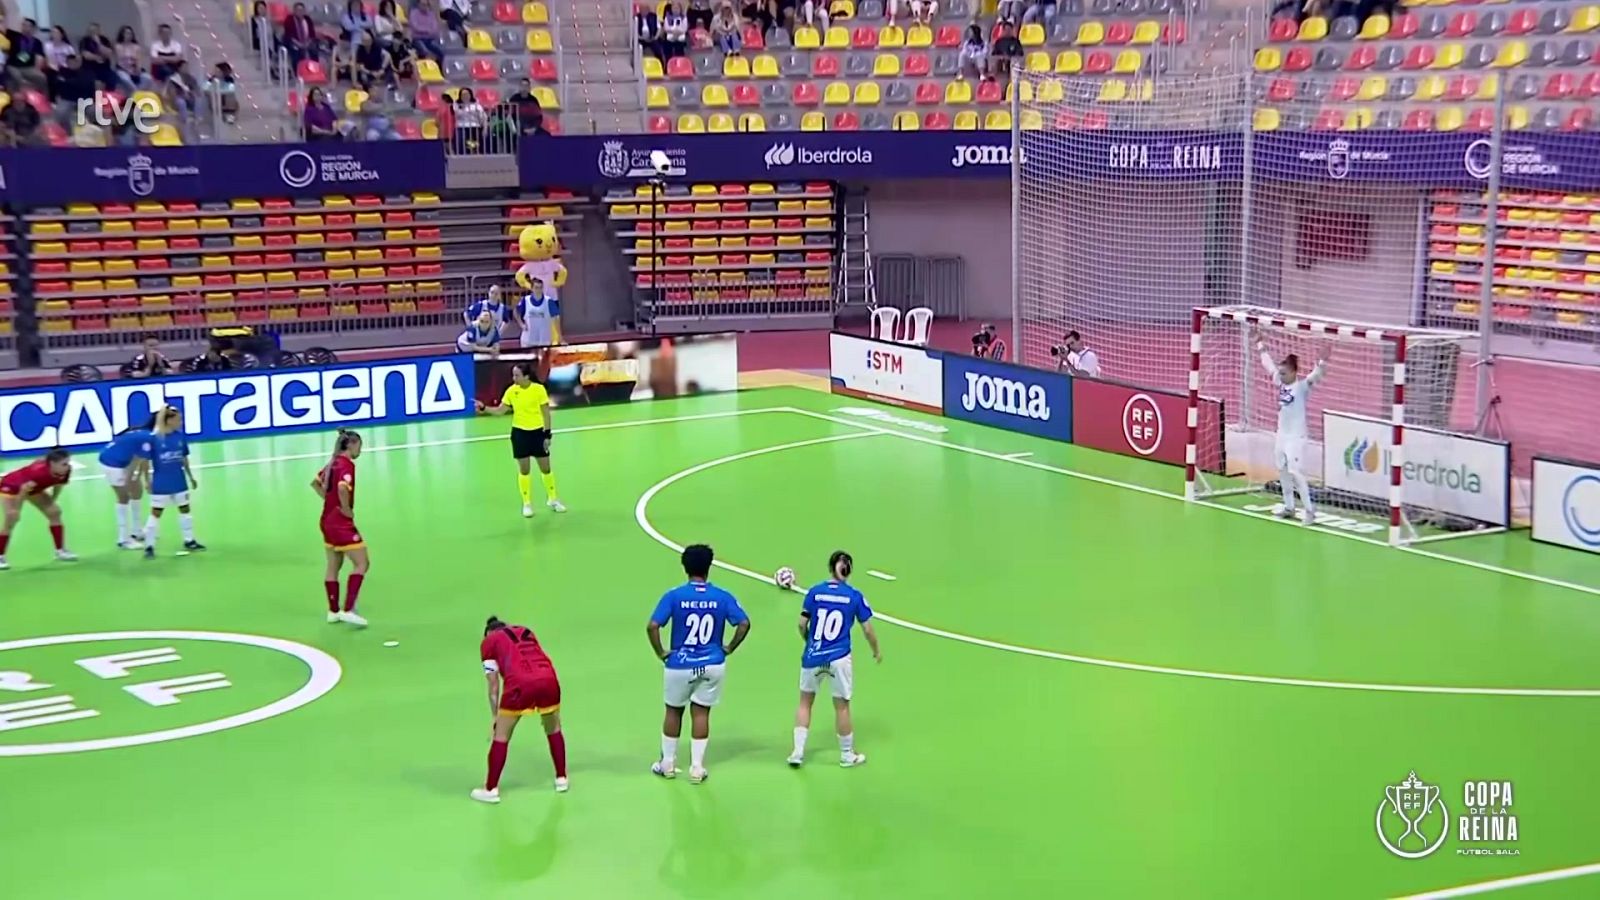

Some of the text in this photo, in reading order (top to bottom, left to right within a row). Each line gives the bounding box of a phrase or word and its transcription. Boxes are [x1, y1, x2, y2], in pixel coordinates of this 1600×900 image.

[798, 146, 873, 164] Iberdrola
[1109, 144, 1221, 168] COPA REINA
[321, 160, 361, 172] REGIÓN
[1502, 164, 1559, 175] DE MURCIA
[322, 169, 380, 182] DE MURCIA
[683, 613, 715, 646] 20
[813, 607, 844, 641] 10
